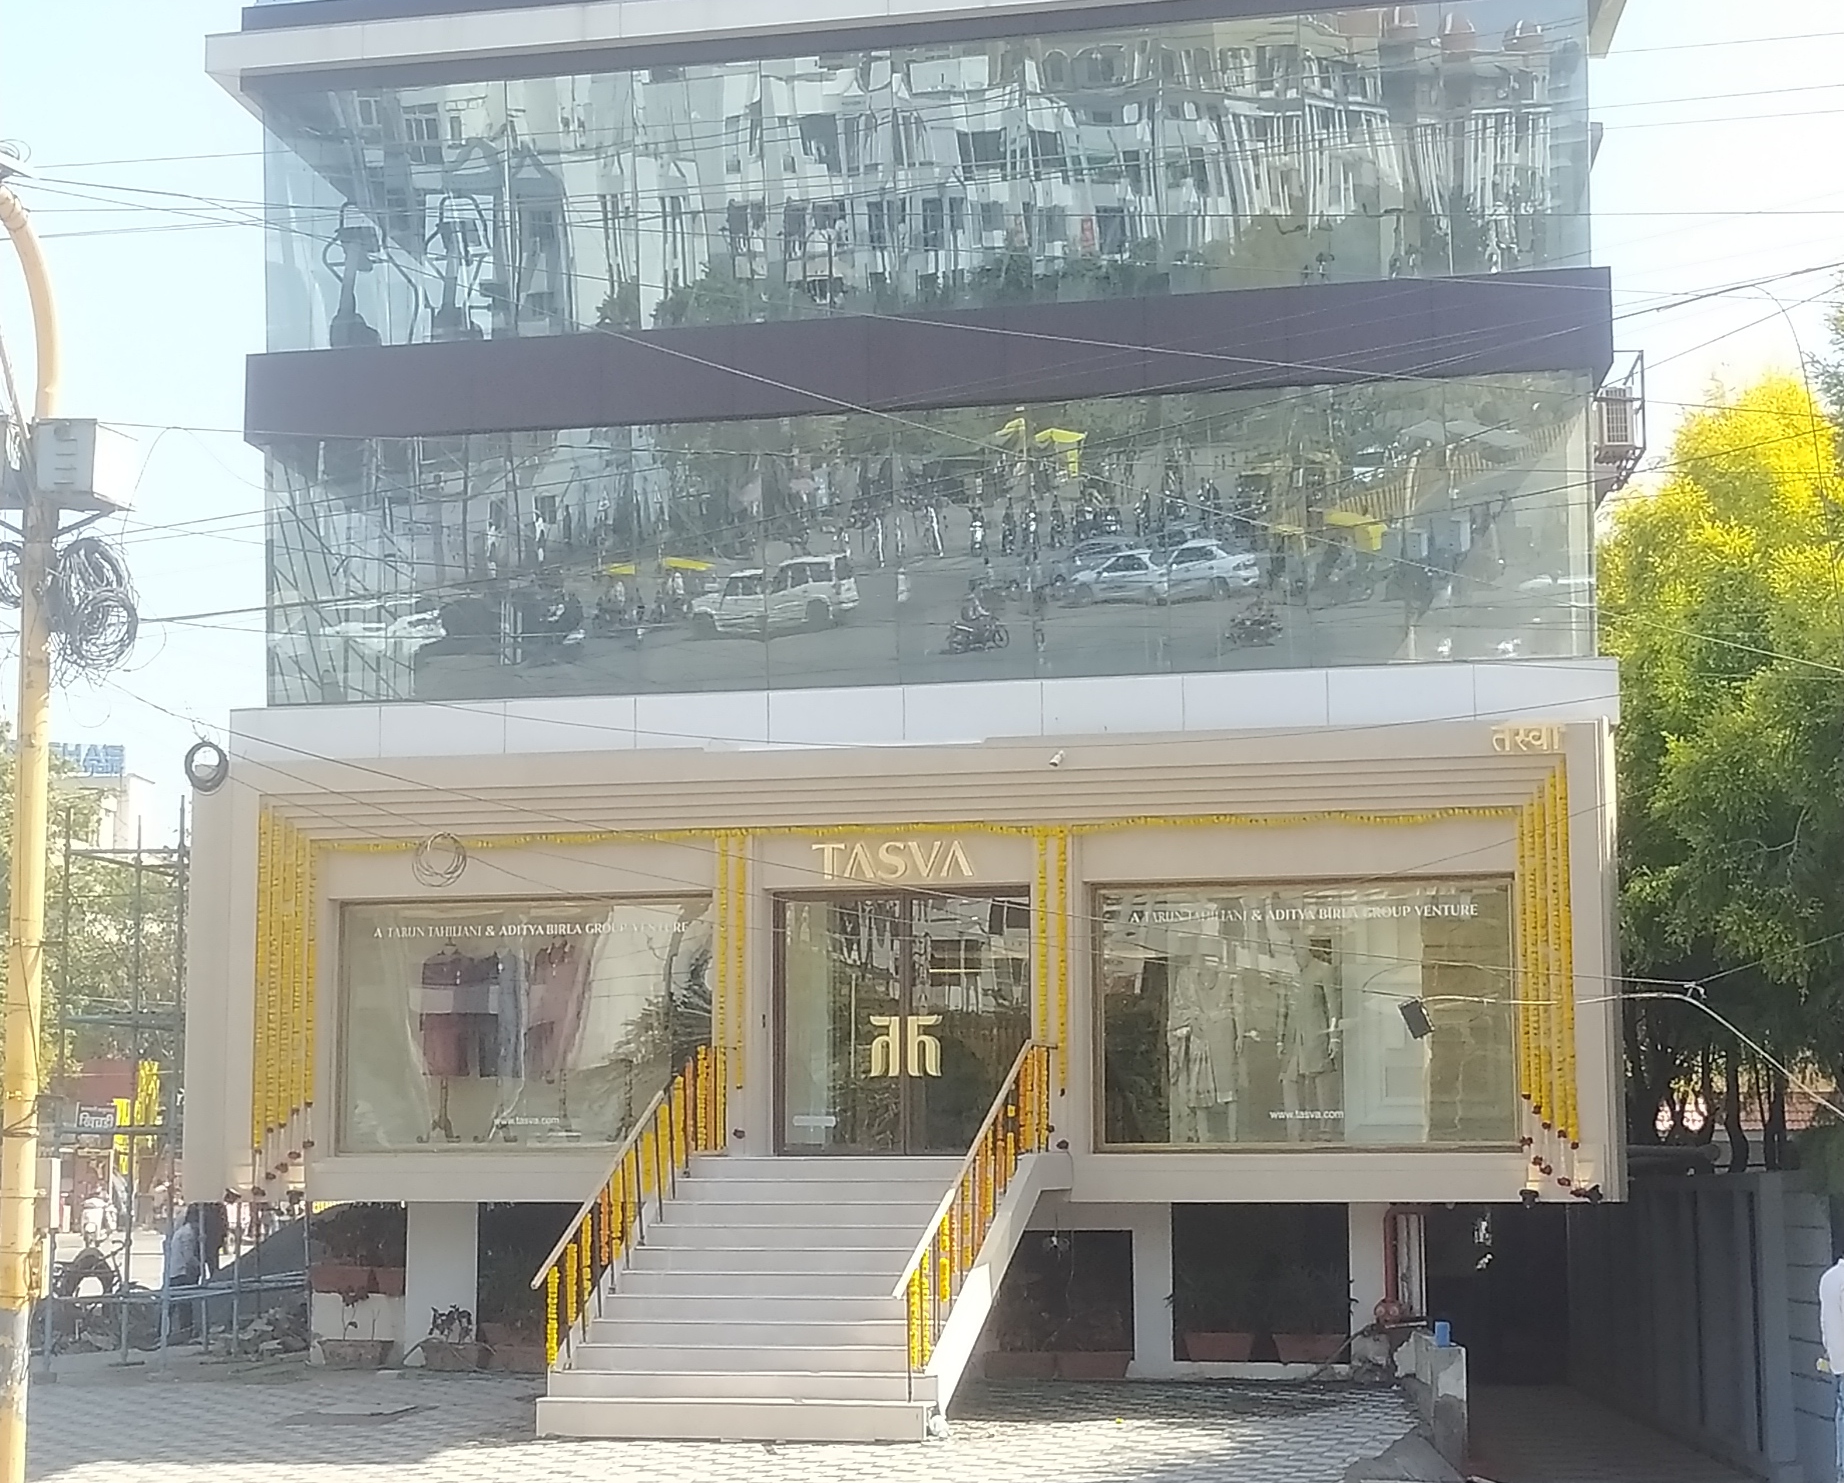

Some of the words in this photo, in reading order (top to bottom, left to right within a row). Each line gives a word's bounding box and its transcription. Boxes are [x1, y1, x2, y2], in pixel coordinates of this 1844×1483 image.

[1491, 723, 1565, 751] तस्वा
[811, 840, 975, 880] TASVA
[1130, 911, 1140, 923] A
[1251, 909, 1262, 921] &
[1268, 908, 1316, 921] ADITYA
[1319, 906, 1358, 919] BIRLA
[1363, 905, 1411, 918] GROUP
[1415, 904, 1479, 917] VENTURE
[374, 927, 382, 938] A
[388, 926, 425, 938] TARUN
[485, 925, 495, 936] &
[499, 923, 545, 936] ADITYA
[546, 923, 582, 935] BIRLA
[585, 922, 627, 934] GROUP
[494, 1116, 560, 1125] www.tasva.com
[1269, 1109, 1344, 1119] www.tasva.com
